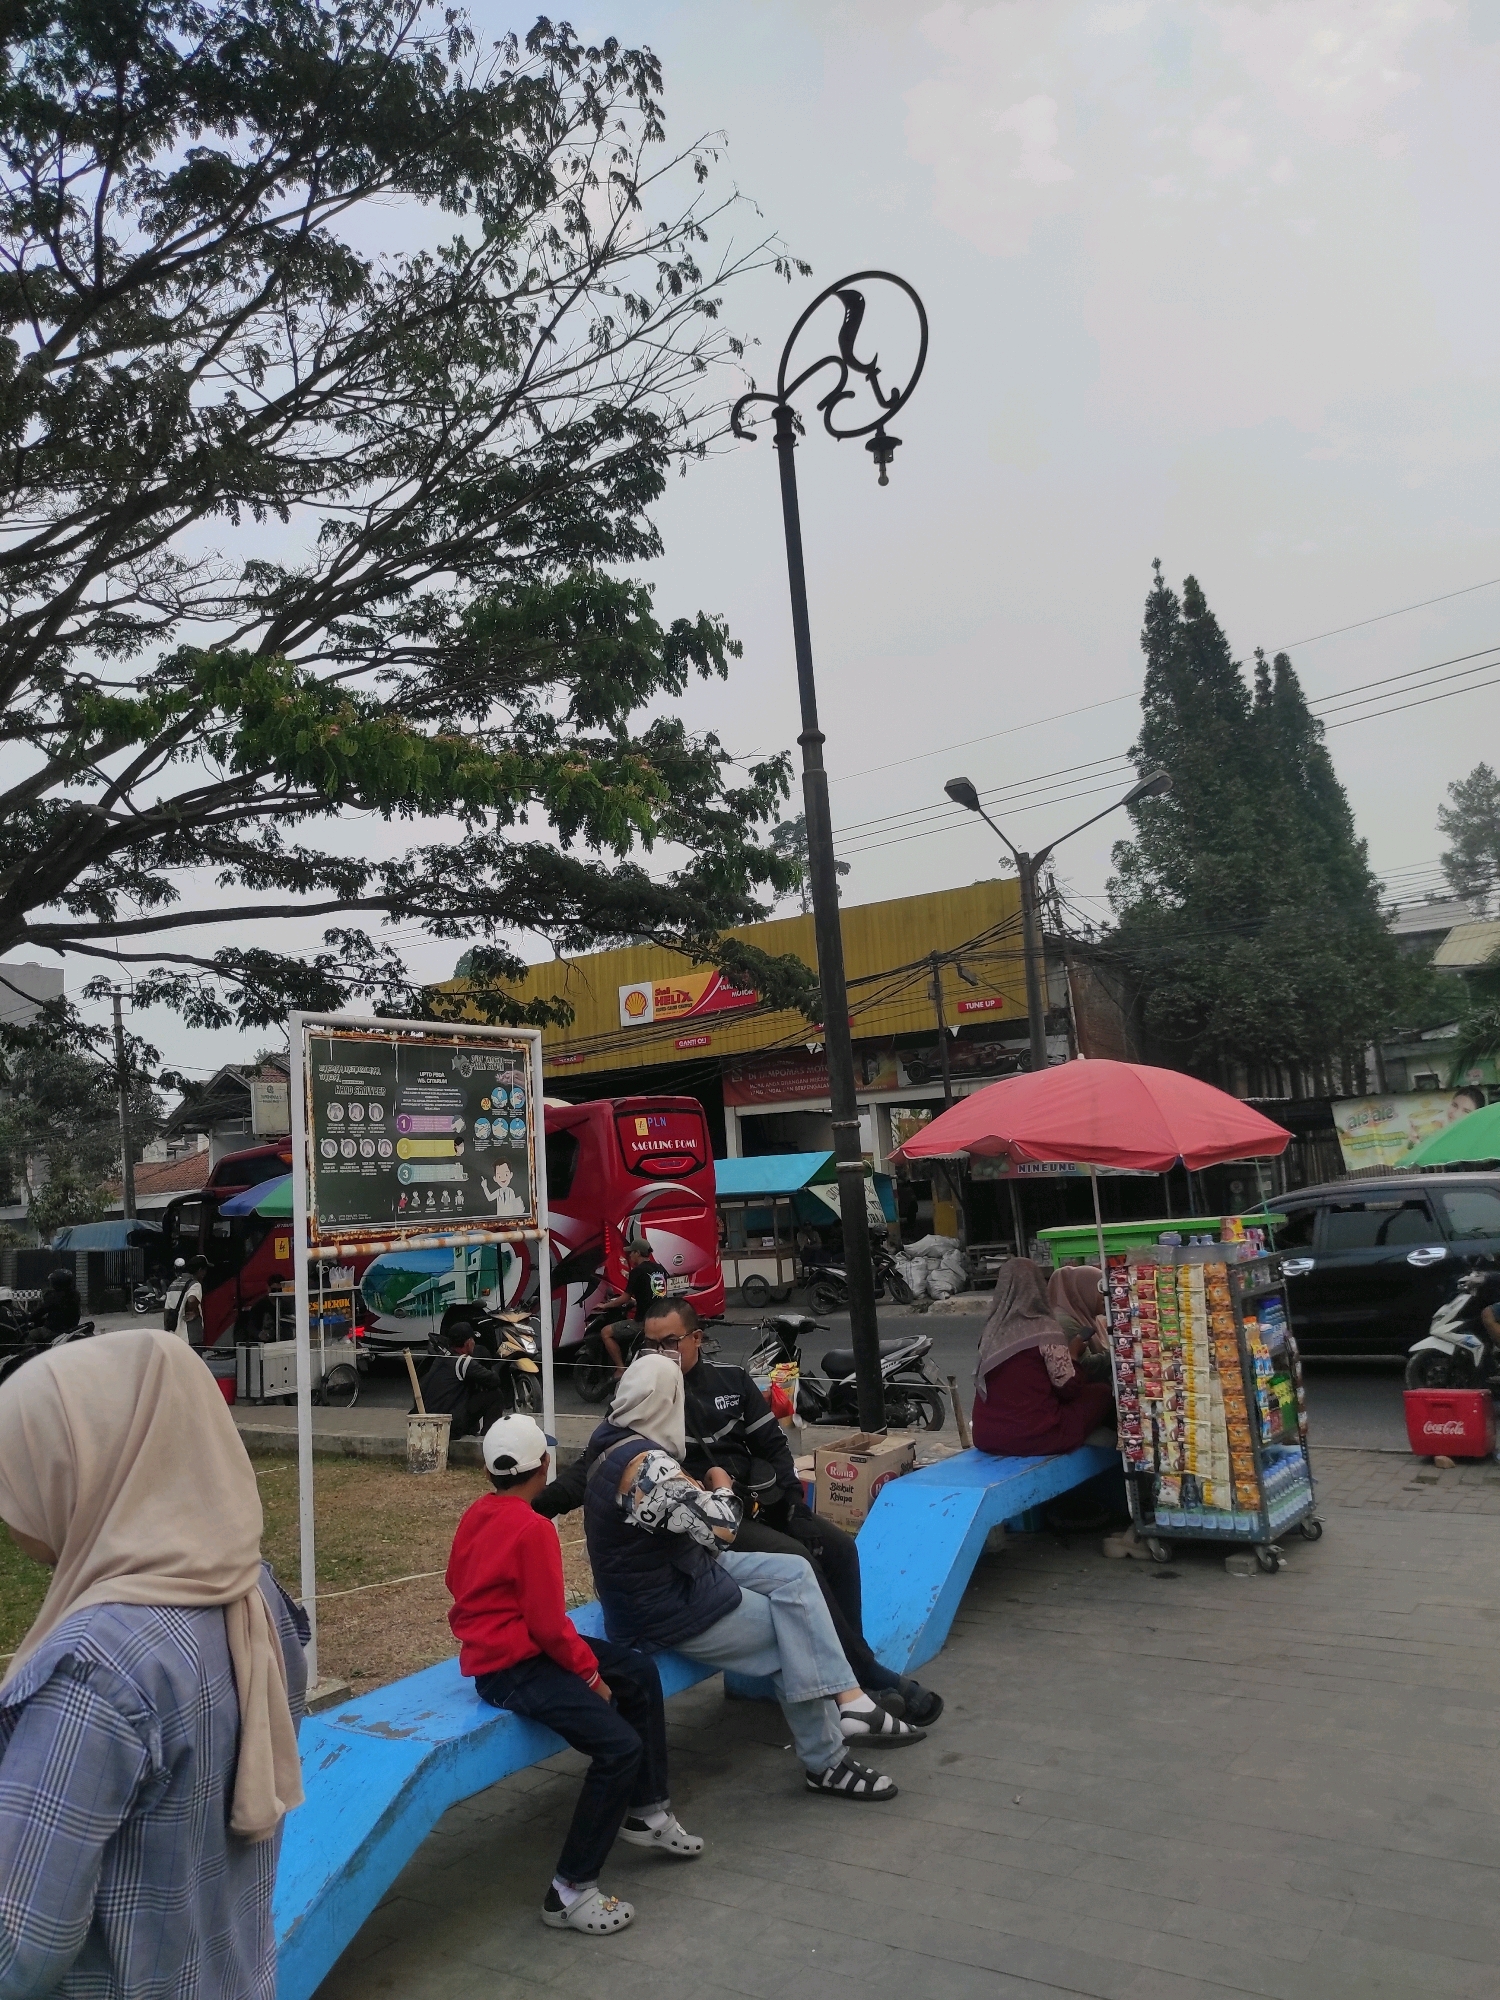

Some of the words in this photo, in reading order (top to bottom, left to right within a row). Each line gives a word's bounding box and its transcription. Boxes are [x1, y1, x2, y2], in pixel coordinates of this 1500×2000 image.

[655, 990, 693, 1006] HELIX
[965, 1001, 984, 1010] TUNE
[401, 1119, 406, 1129] 1
[647, 1117, 667, 1127] PLN
[401, 1144, 408, 1153] 2
[631, 1139, 674, 1151] SAGULING
[402, 1169, 408, 1179] 3
[1017, 1162, 1077, 1174] NINEUNG
[830, 1465, 854, 1478] Roma
[829, 1482, 854, 1494] Biskuit
[829, 1492, 853, 1504] Kelapa
